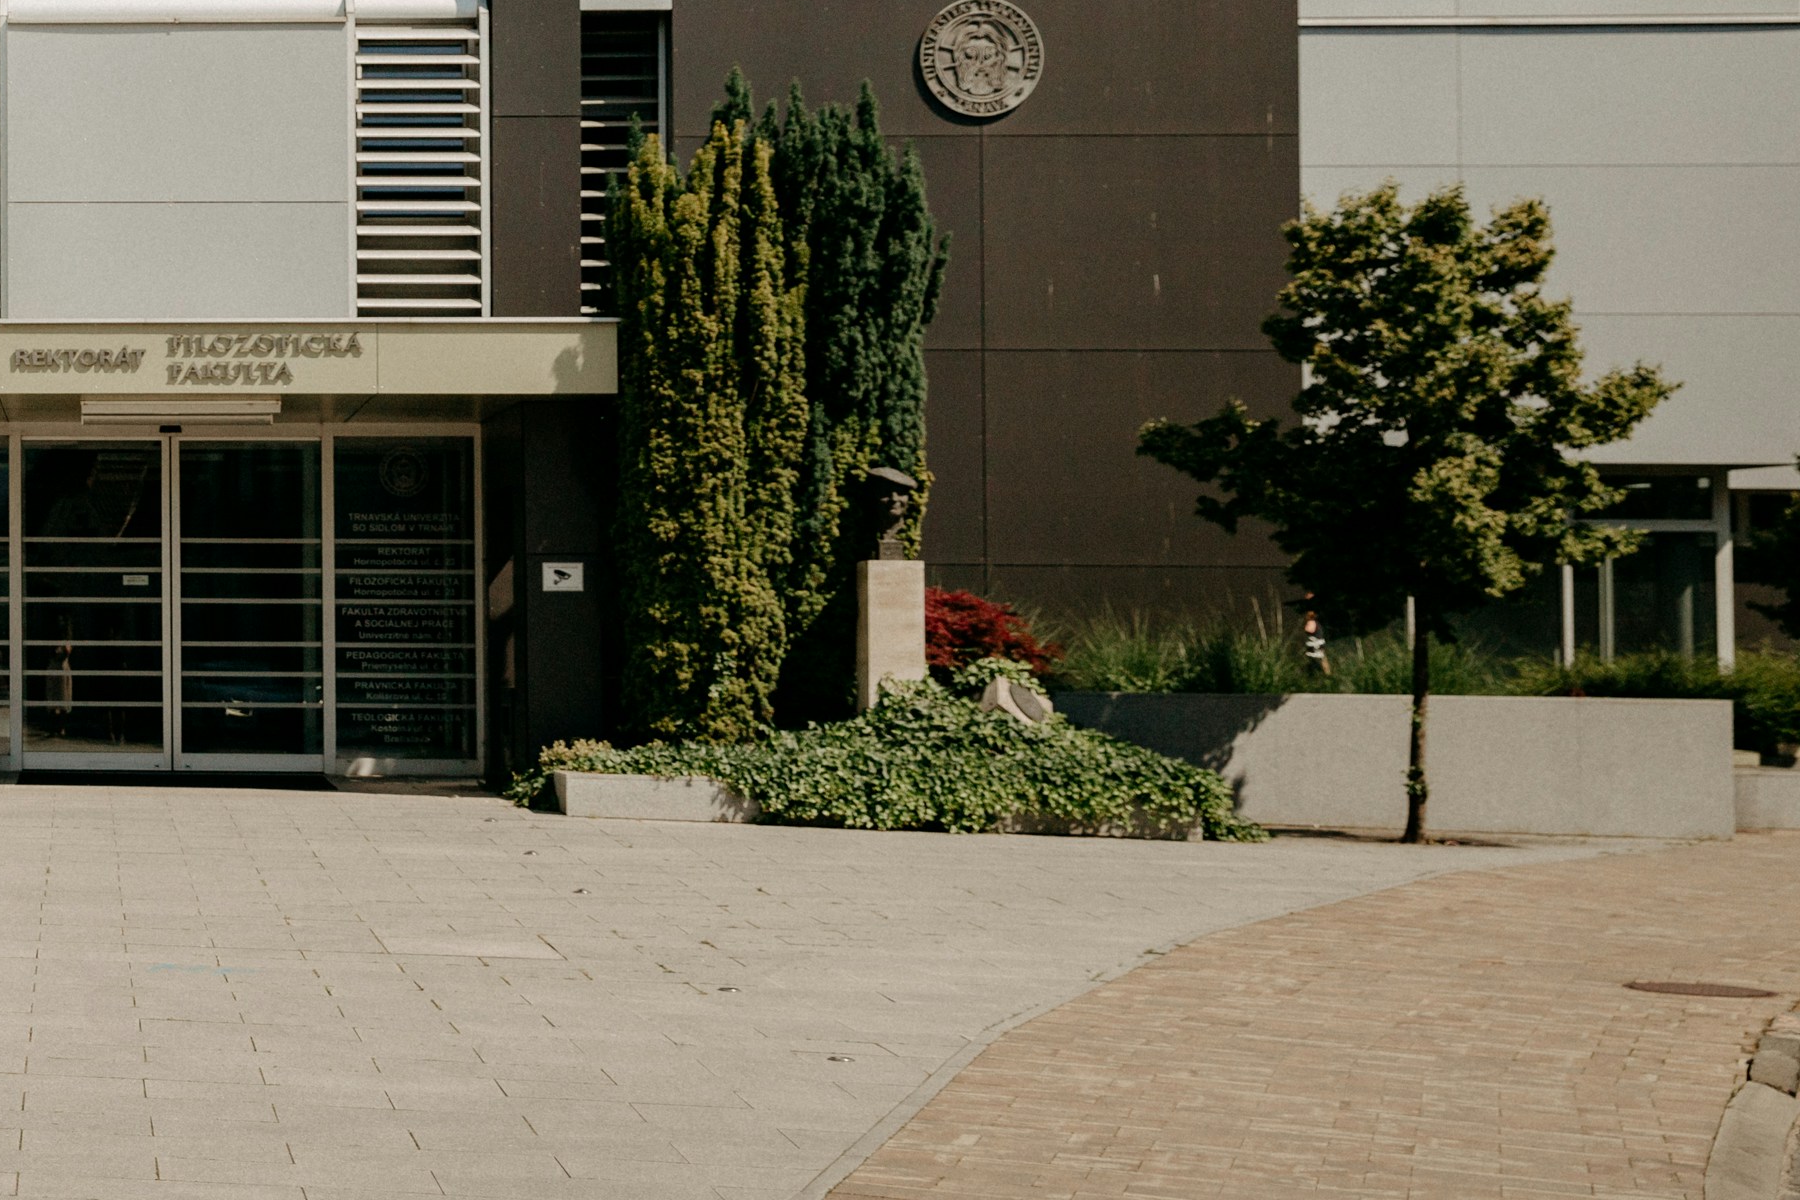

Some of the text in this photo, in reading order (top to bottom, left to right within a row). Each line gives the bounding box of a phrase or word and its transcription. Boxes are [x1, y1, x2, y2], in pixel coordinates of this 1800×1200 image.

[171, 331, 363, 356] FILOZOFICKÁ
[13, 345, 146, 369] REKTORÁT
[171, 361, 293, 383] FAKULTA
